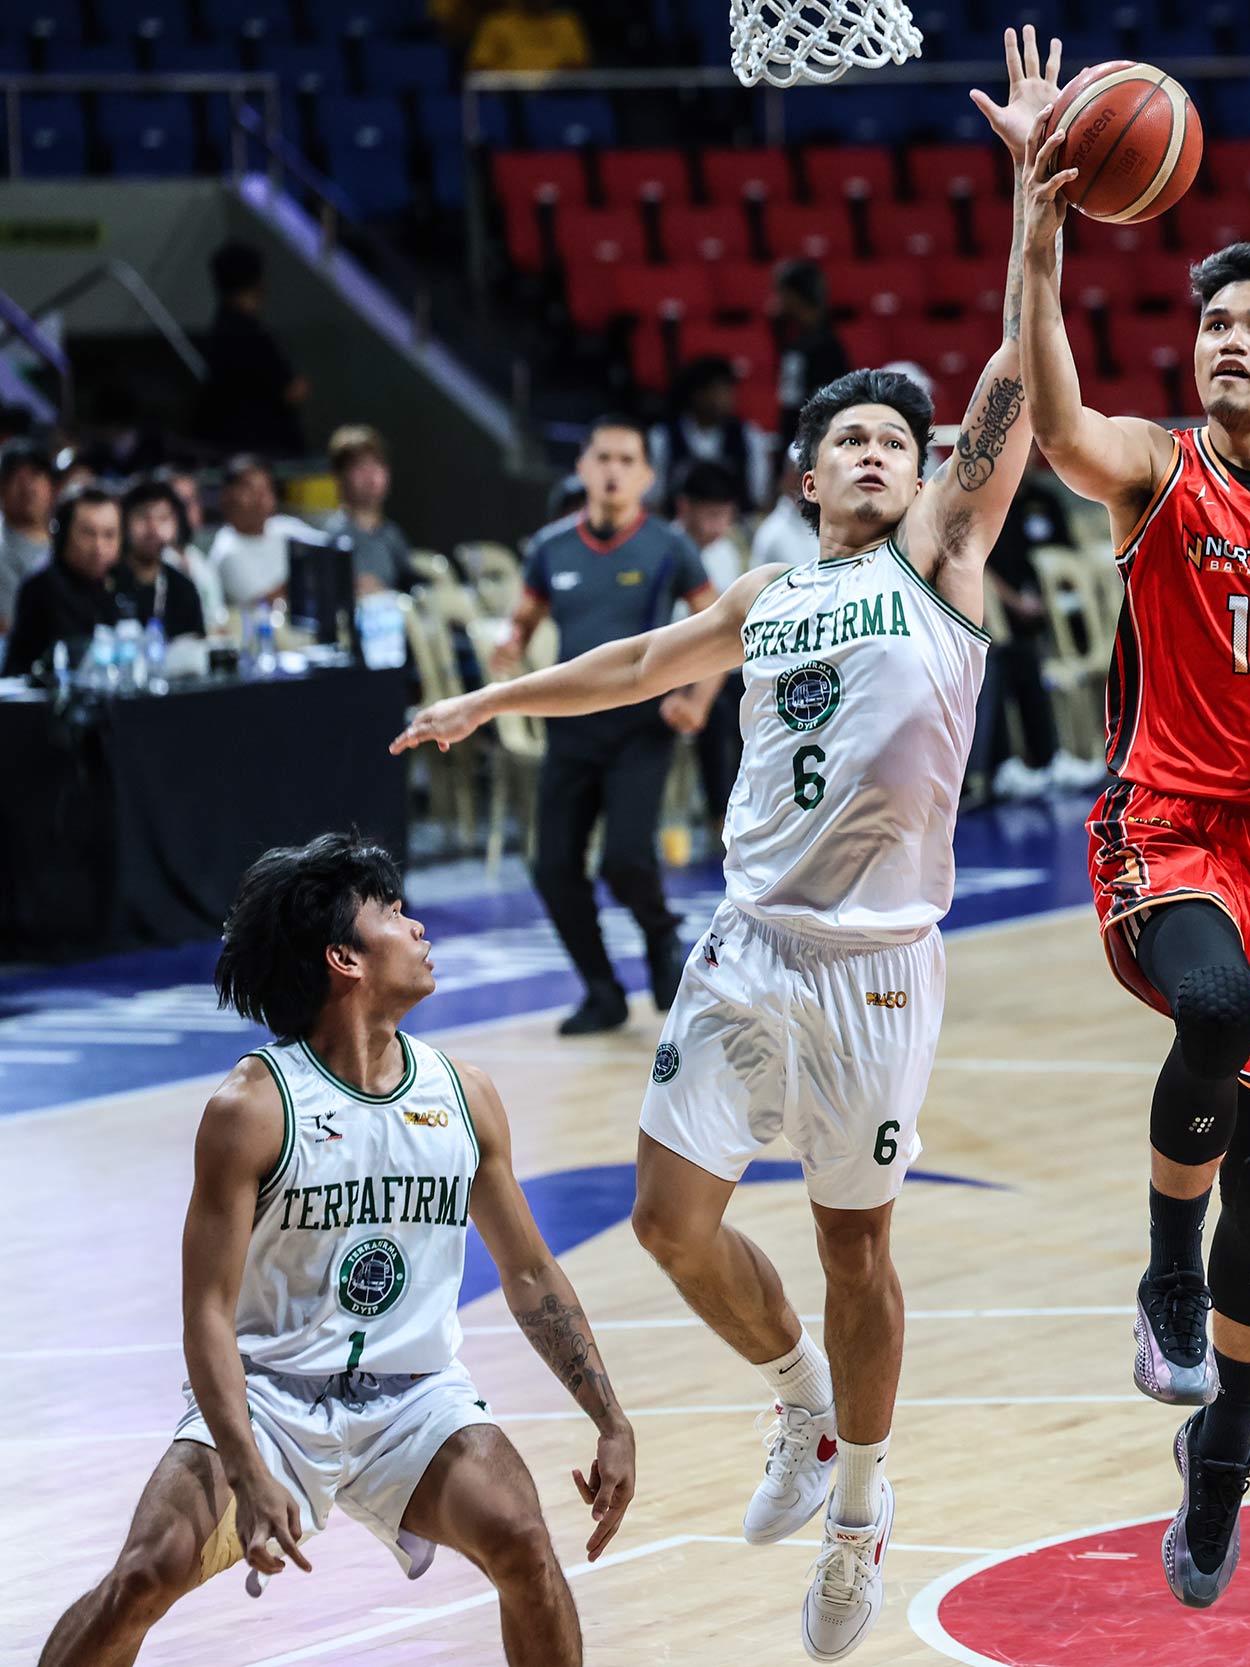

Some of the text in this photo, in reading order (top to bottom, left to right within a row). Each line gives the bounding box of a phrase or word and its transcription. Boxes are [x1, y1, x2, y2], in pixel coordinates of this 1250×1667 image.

[1071, 108, 1117, 168] molten
[797, 719, 818, 730] DYIP
[792, 743, 826, 811] 6
[873, 1120, 900, 1166] 6
[351, 1303, 379, 1315] DYIP
[347, 1330, 367, 1372] 1
